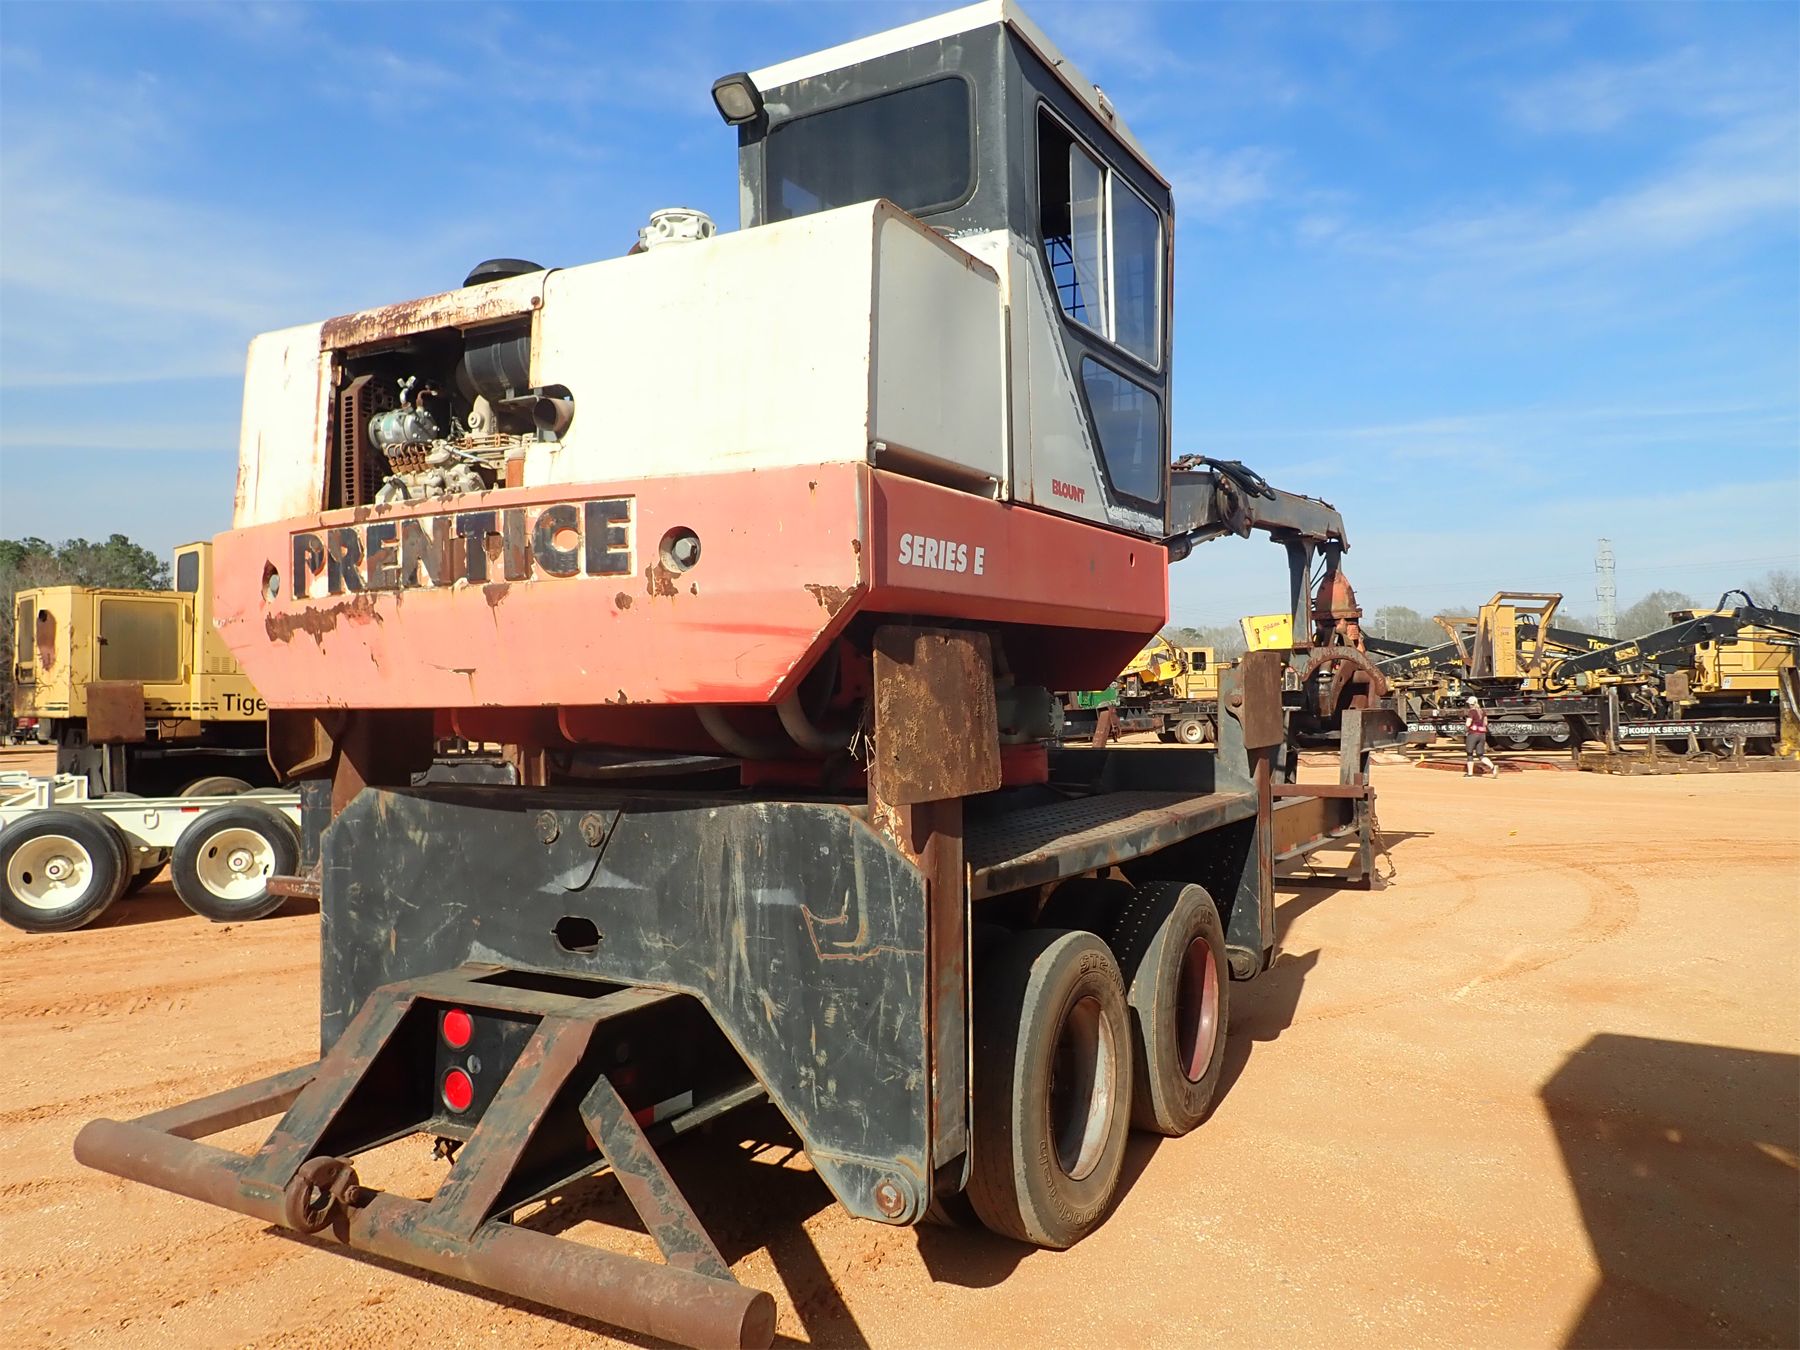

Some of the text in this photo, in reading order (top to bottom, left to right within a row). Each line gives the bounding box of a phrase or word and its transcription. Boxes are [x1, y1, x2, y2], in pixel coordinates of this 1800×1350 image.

[1052, 480, 1085, 503] BLOUNT
[293, 500, 632, 600] PRENTICE
[898, 533, 985, 575] SERIES E
[1629, 726, 1661, 734] KODIAK
